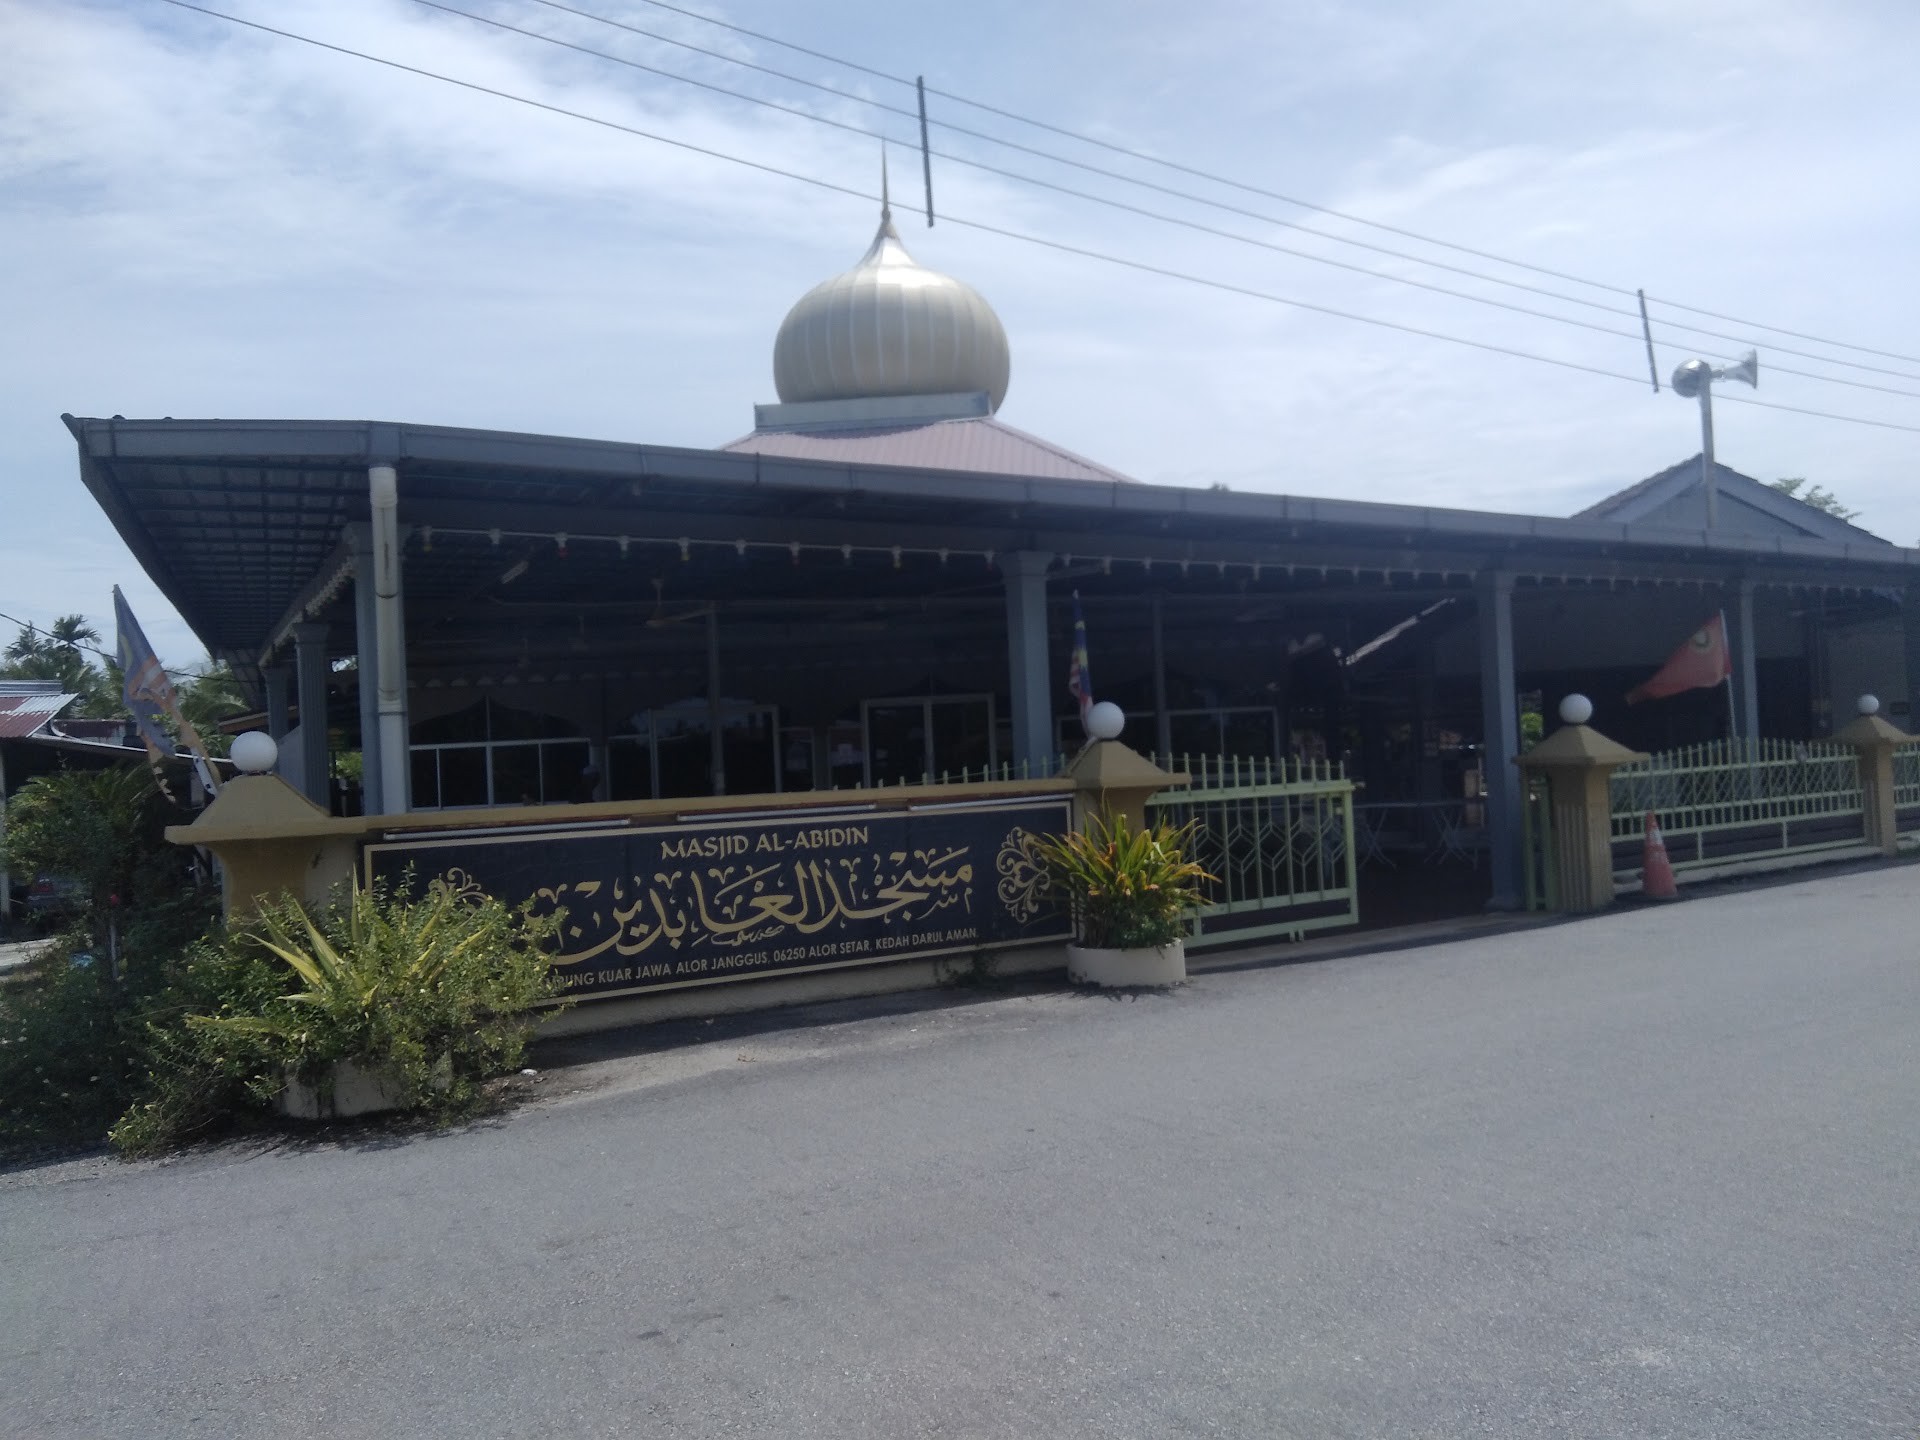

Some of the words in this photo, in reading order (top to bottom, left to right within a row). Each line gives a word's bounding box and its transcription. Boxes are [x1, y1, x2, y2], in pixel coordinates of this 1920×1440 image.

[661, 835, 749, 860] MASJID
[755, 826, 869, 852] AL-ABIDIN
[598, 968, 632, 984] KUAR
[635, 962, 672, 978] JAWA
[676, 959, 708, 973] ALOR
[773, 948, 806, 962] 06250
[808, 943, 837, 957] ALOR
[875, 935, 910, 950] KEDAH
[912, 930, 944, 945] DARUL
